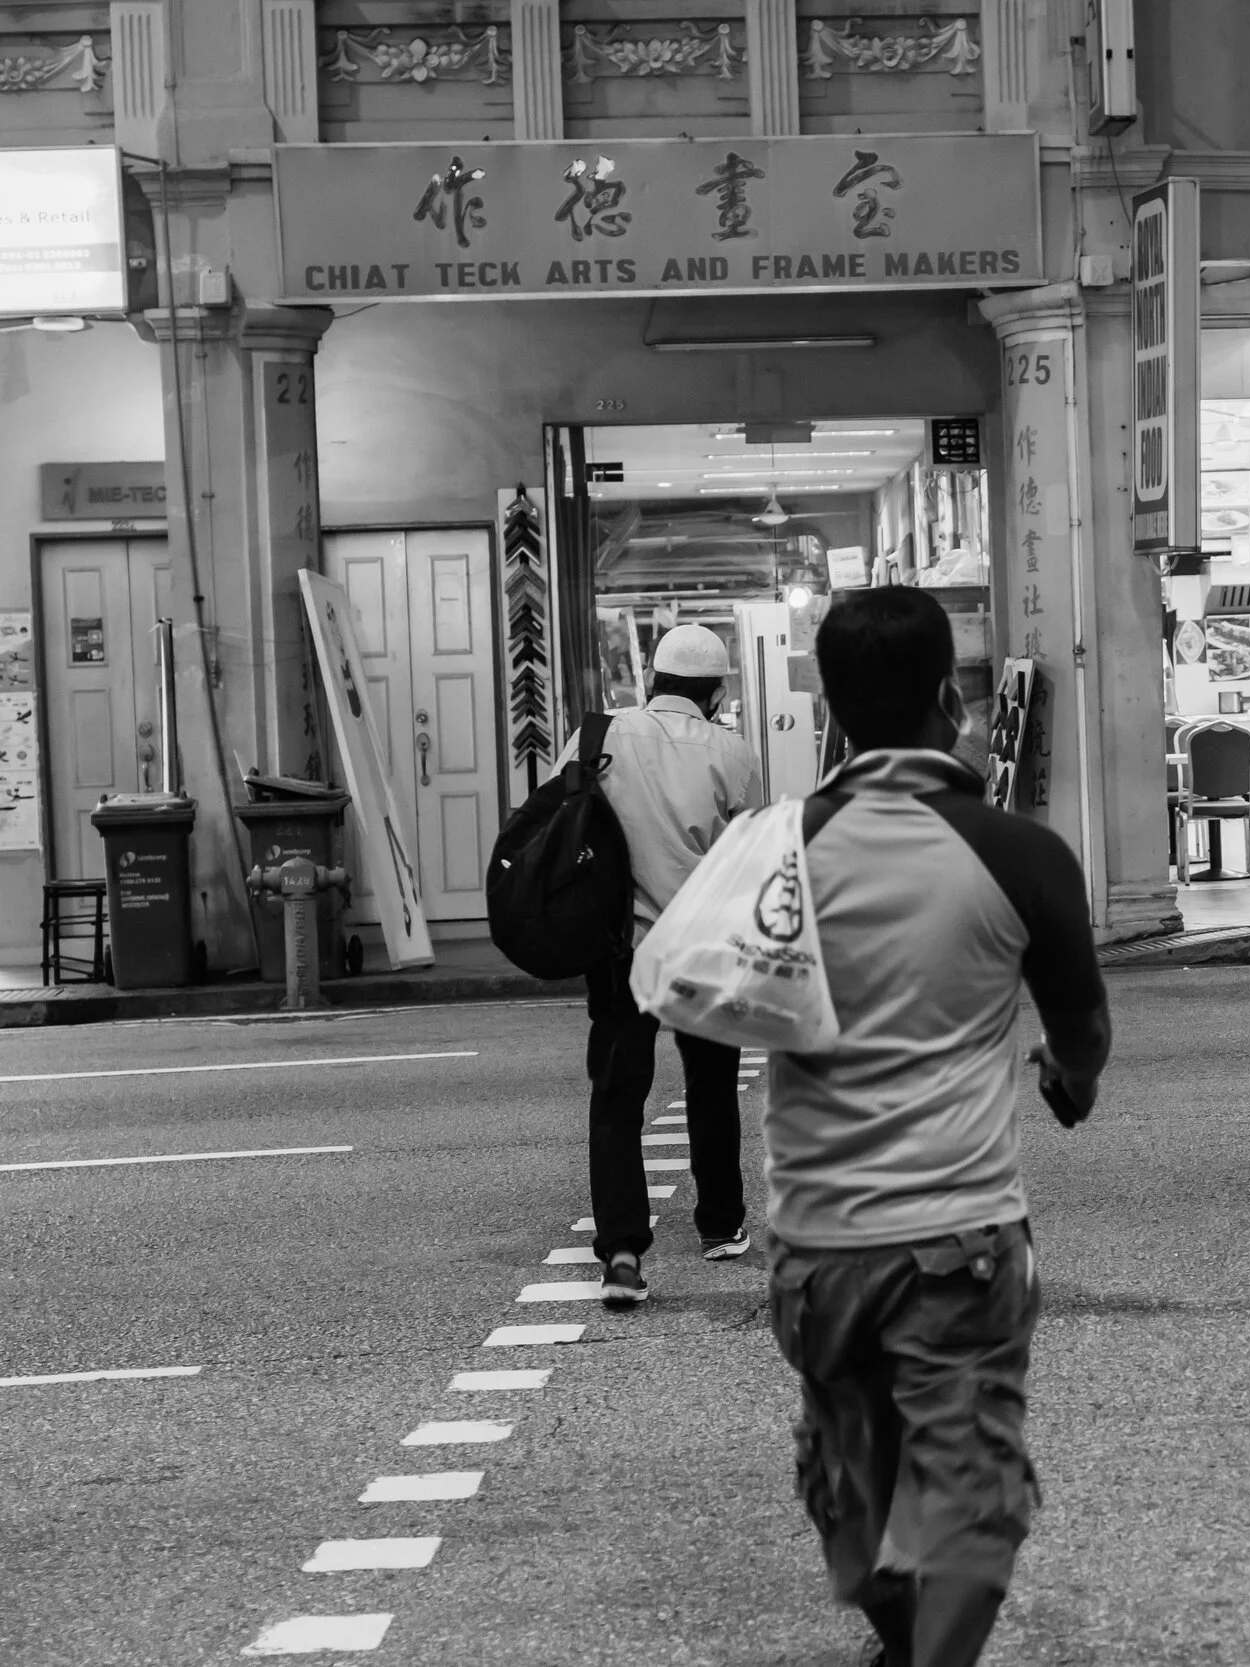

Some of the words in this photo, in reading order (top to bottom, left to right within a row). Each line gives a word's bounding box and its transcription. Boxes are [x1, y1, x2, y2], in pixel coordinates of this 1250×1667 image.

[38, 209, 90, 223] Retail
[305, 264, 410, 290] CHIAT
[435, 261, 521, 287] TECK
[546, 258, 636, 284] ARTS
[661, 256, 728, 282] AND
[752, 253, 865, 280] FRAME
[884, 249, 1021, 277] MAKERS
[1007, 354, 1050, 386] 225
[1137, 354, 1166, 421] INDIAN
[596, 399, 626, 411] 225
[1140, 426, 1163, 490] FOOD
